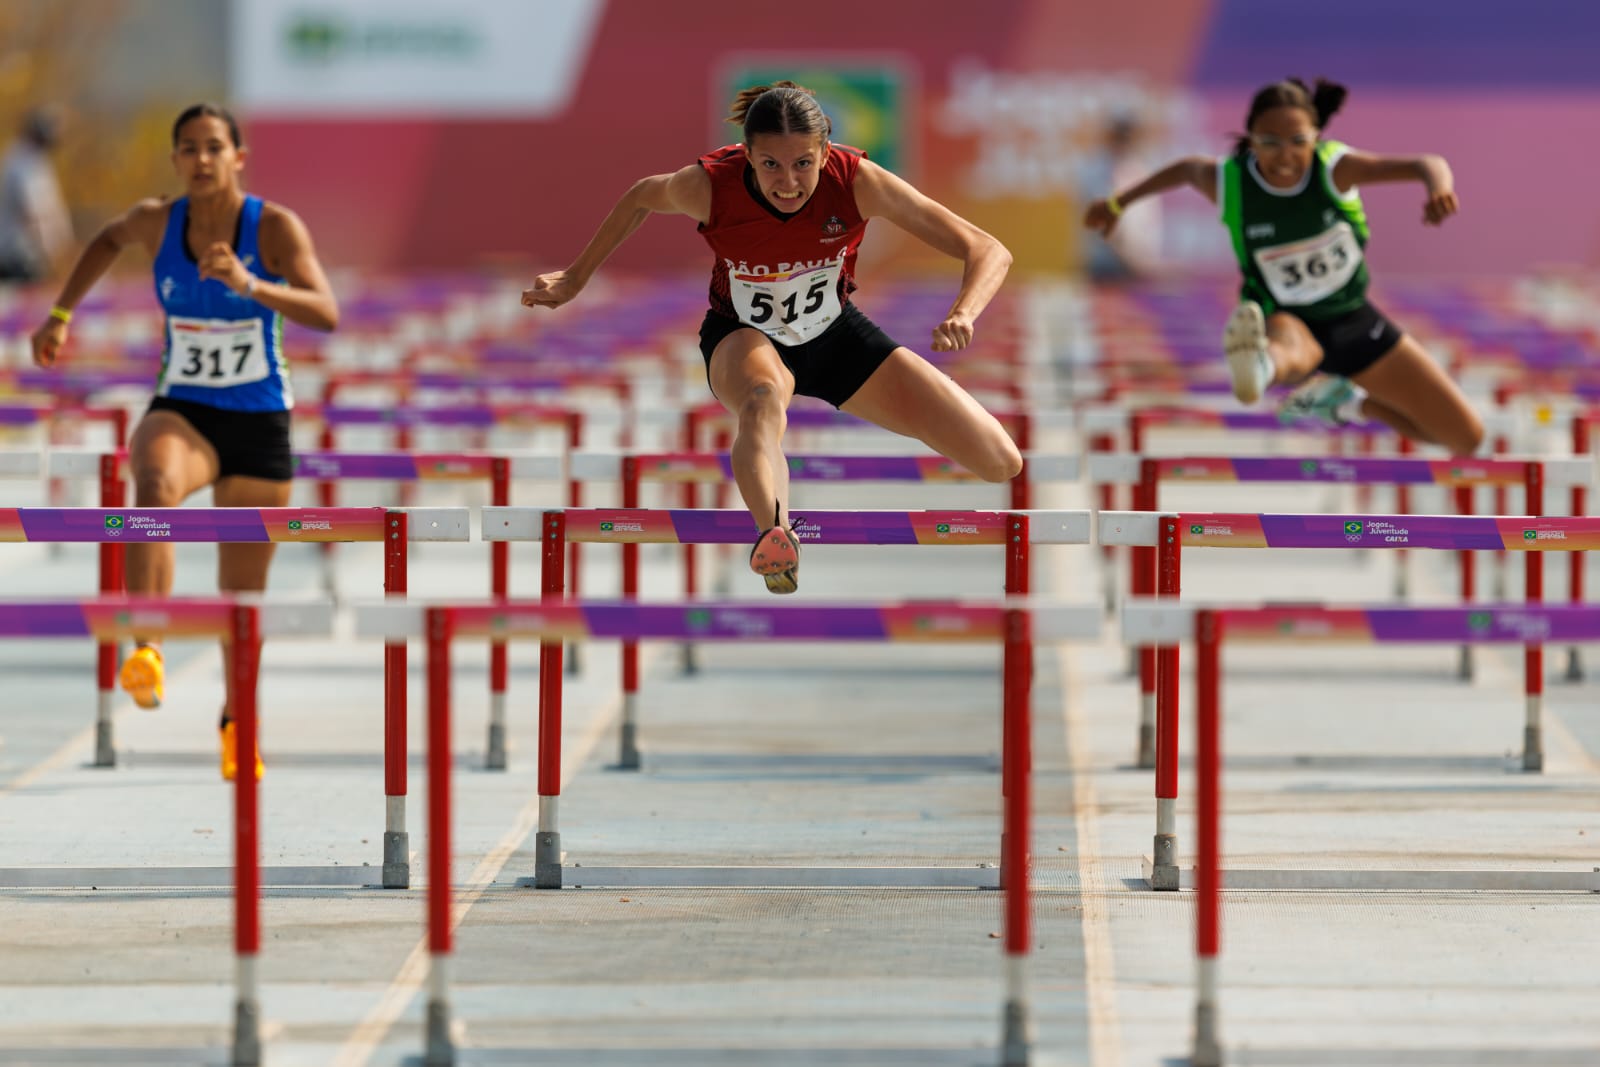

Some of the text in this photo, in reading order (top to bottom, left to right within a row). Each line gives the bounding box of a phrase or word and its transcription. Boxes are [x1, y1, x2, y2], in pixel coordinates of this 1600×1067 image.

[1279, 245, 1348, 288] 363
[750, 280, 828, 324] 515
[181, 344, 254, 379] 317
[127, 515, 149, 524] Jogos
[1366, 521, 1389, 530] Jogos
